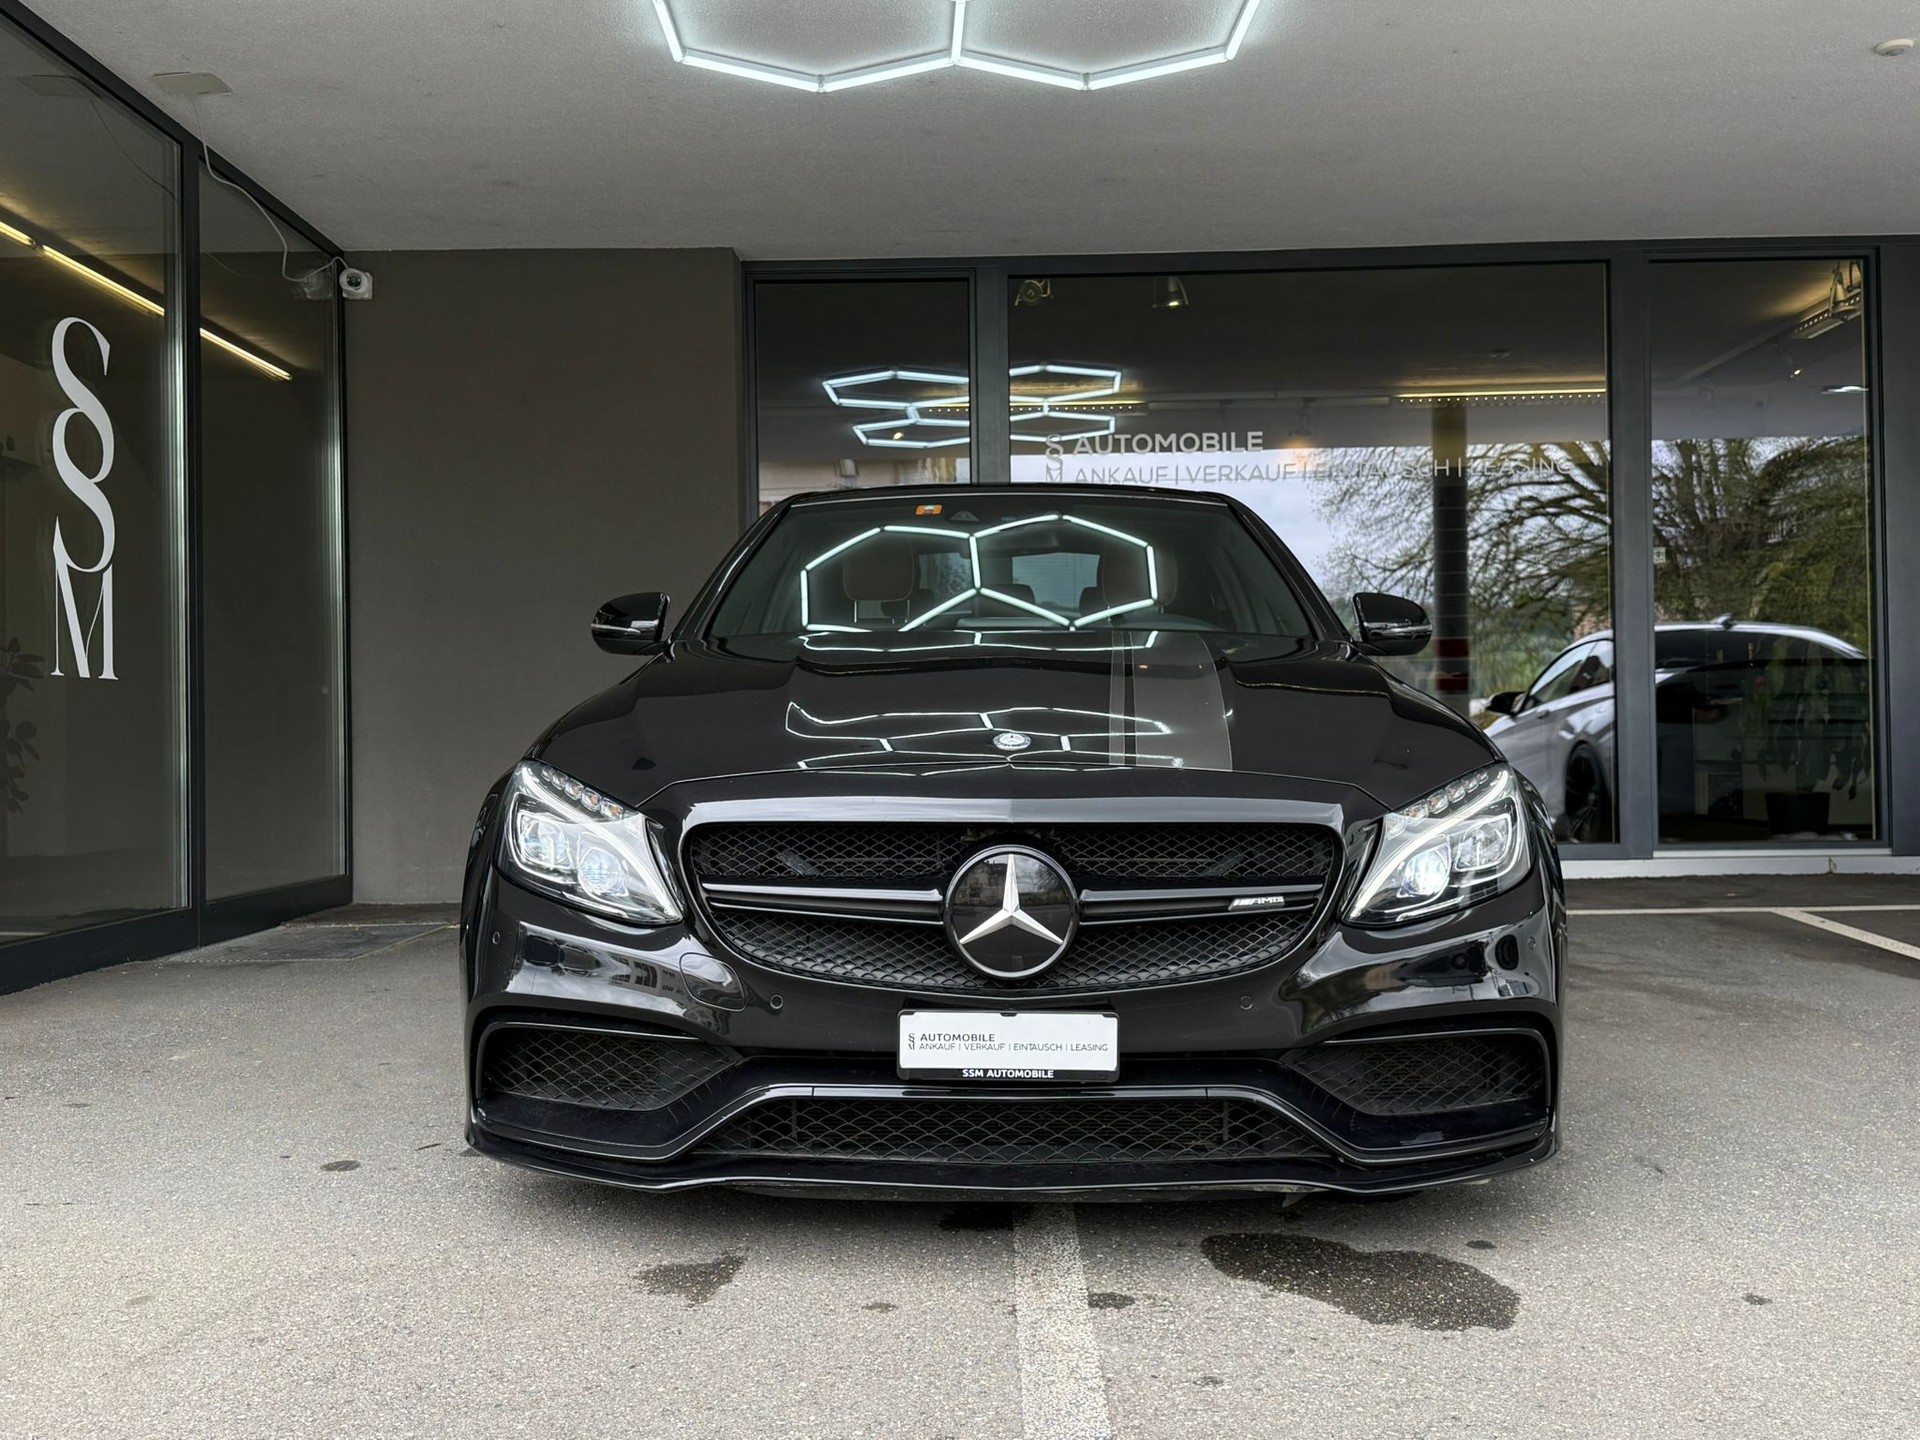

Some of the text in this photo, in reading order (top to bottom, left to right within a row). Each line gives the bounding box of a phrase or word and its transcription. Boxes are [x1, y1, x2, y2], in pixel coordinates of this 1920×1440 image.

[1073, 431, 1263, 455] AUTOMOBILE
[1076, 465, 1169, 484] ANKAUF
[1186, 463, 1296, 483] VERKAUF
[1471, 456, 1572, 476] LEASING
[920, 1033, 996, 1042] AUTOMOBILE
[919, 1042, 955, 1050] ANKAUF
[964, 1042, 1005, 1051] VERKAUF
[1013, 1043, 1062, 1051] EINTAUSCH
[1070, 1043, 1108, 1051] LEASING
[962, 1069, 1054, 1078] SSM AUTOMOBILE
